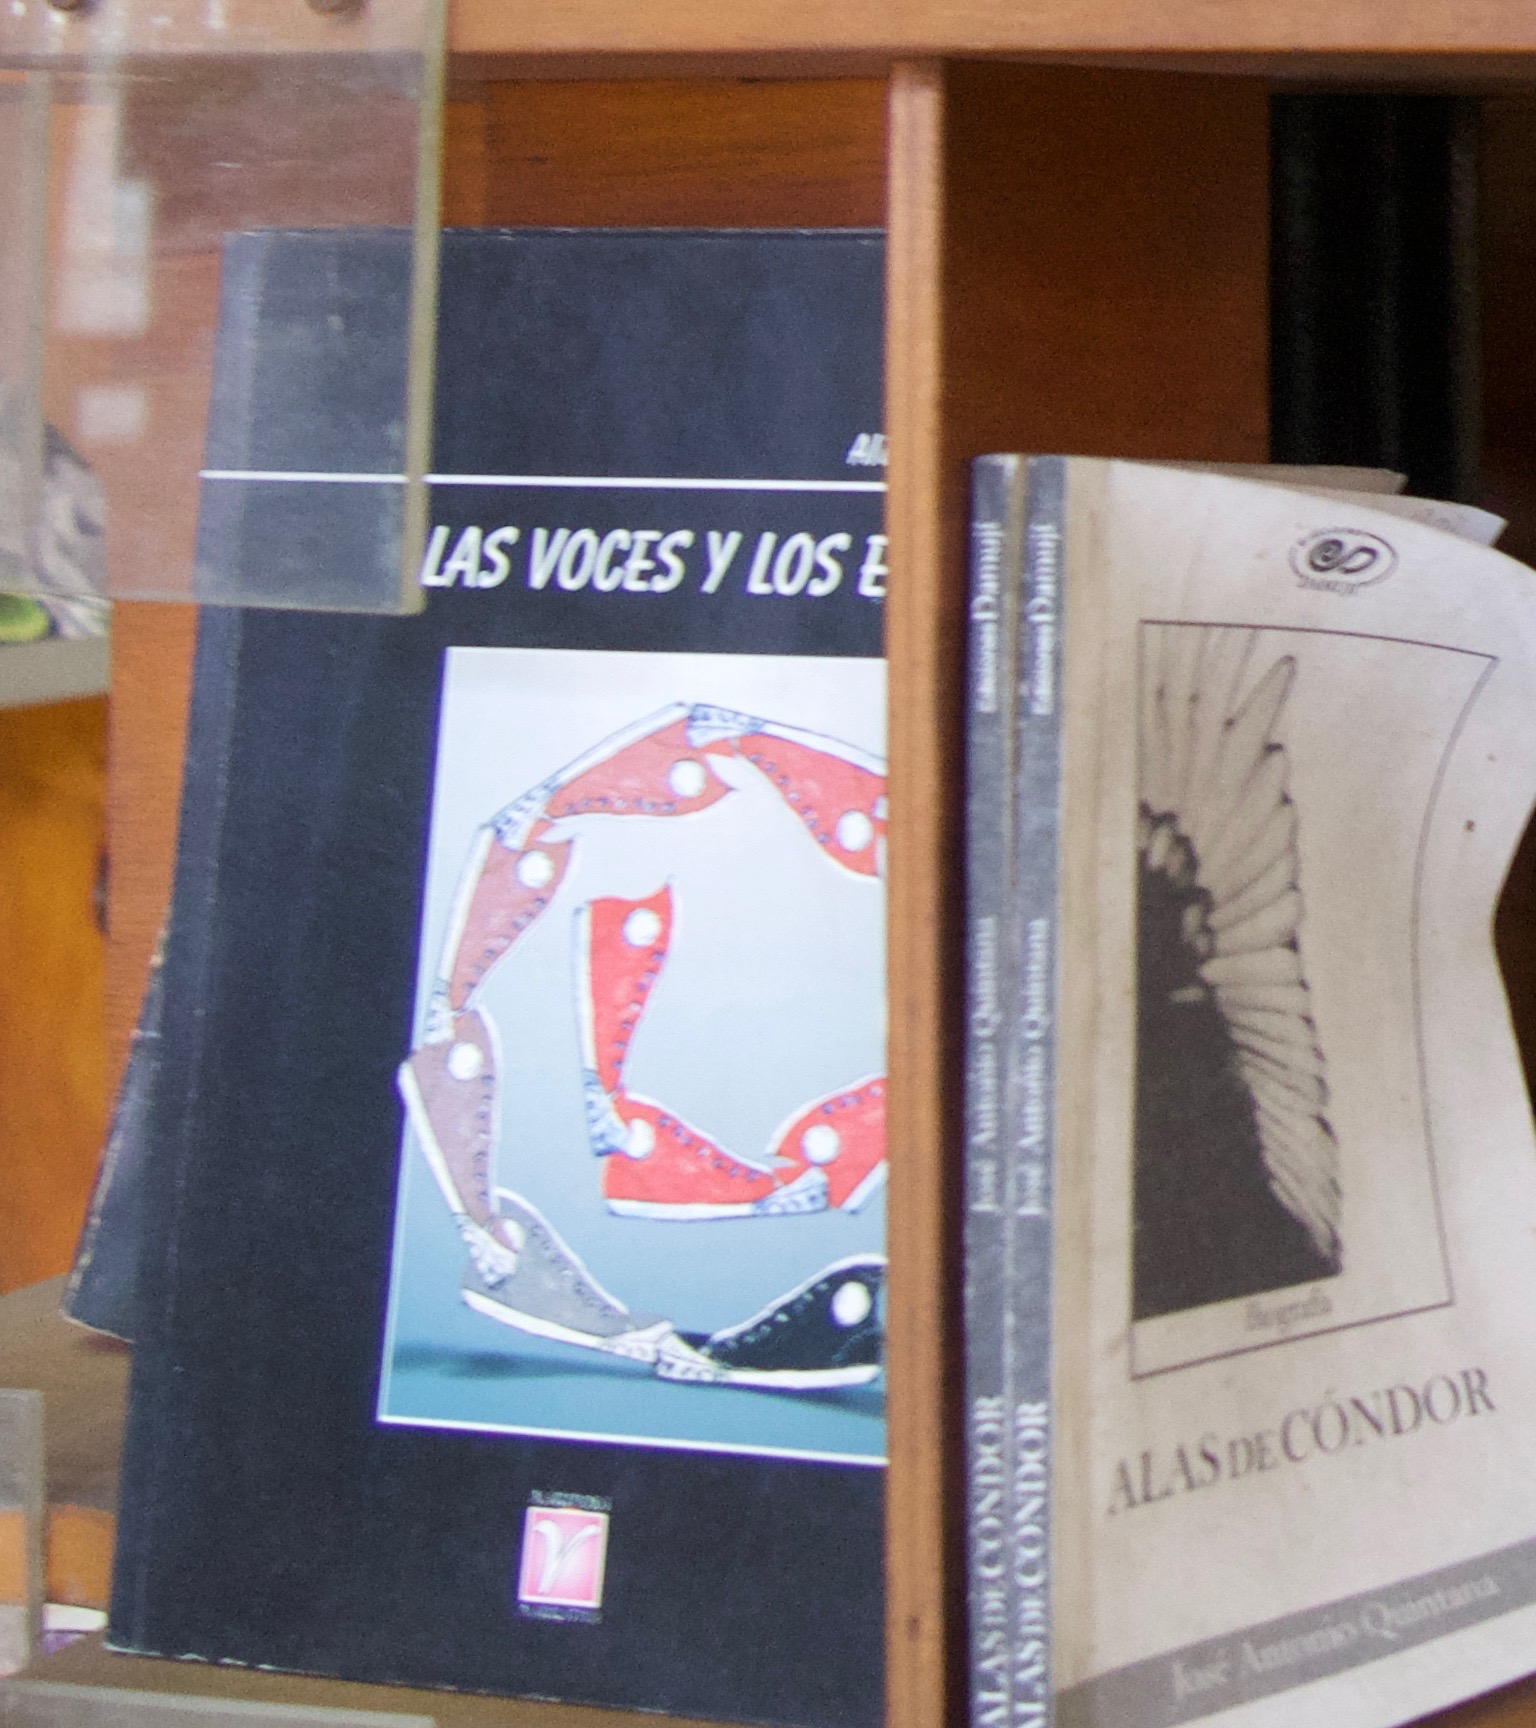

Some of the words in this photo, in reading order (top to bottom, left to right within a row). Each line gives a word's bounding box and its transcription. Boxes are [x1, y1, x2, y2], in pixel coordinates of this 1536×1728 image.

[420, 524, 520, 589] LAS
[528, 527, 695, 593] VOCES
[701, 530, 744, 595] Y
[746, 531, 853, 599] LOS
[1106, 1433, 1223, 1517] ALAS
[1224, 1427, 1278, 1477] DE
[1279, 1367, 1498, 1464] CÓNDOR
[1358, 1574, 1501, 1644] Quintana
